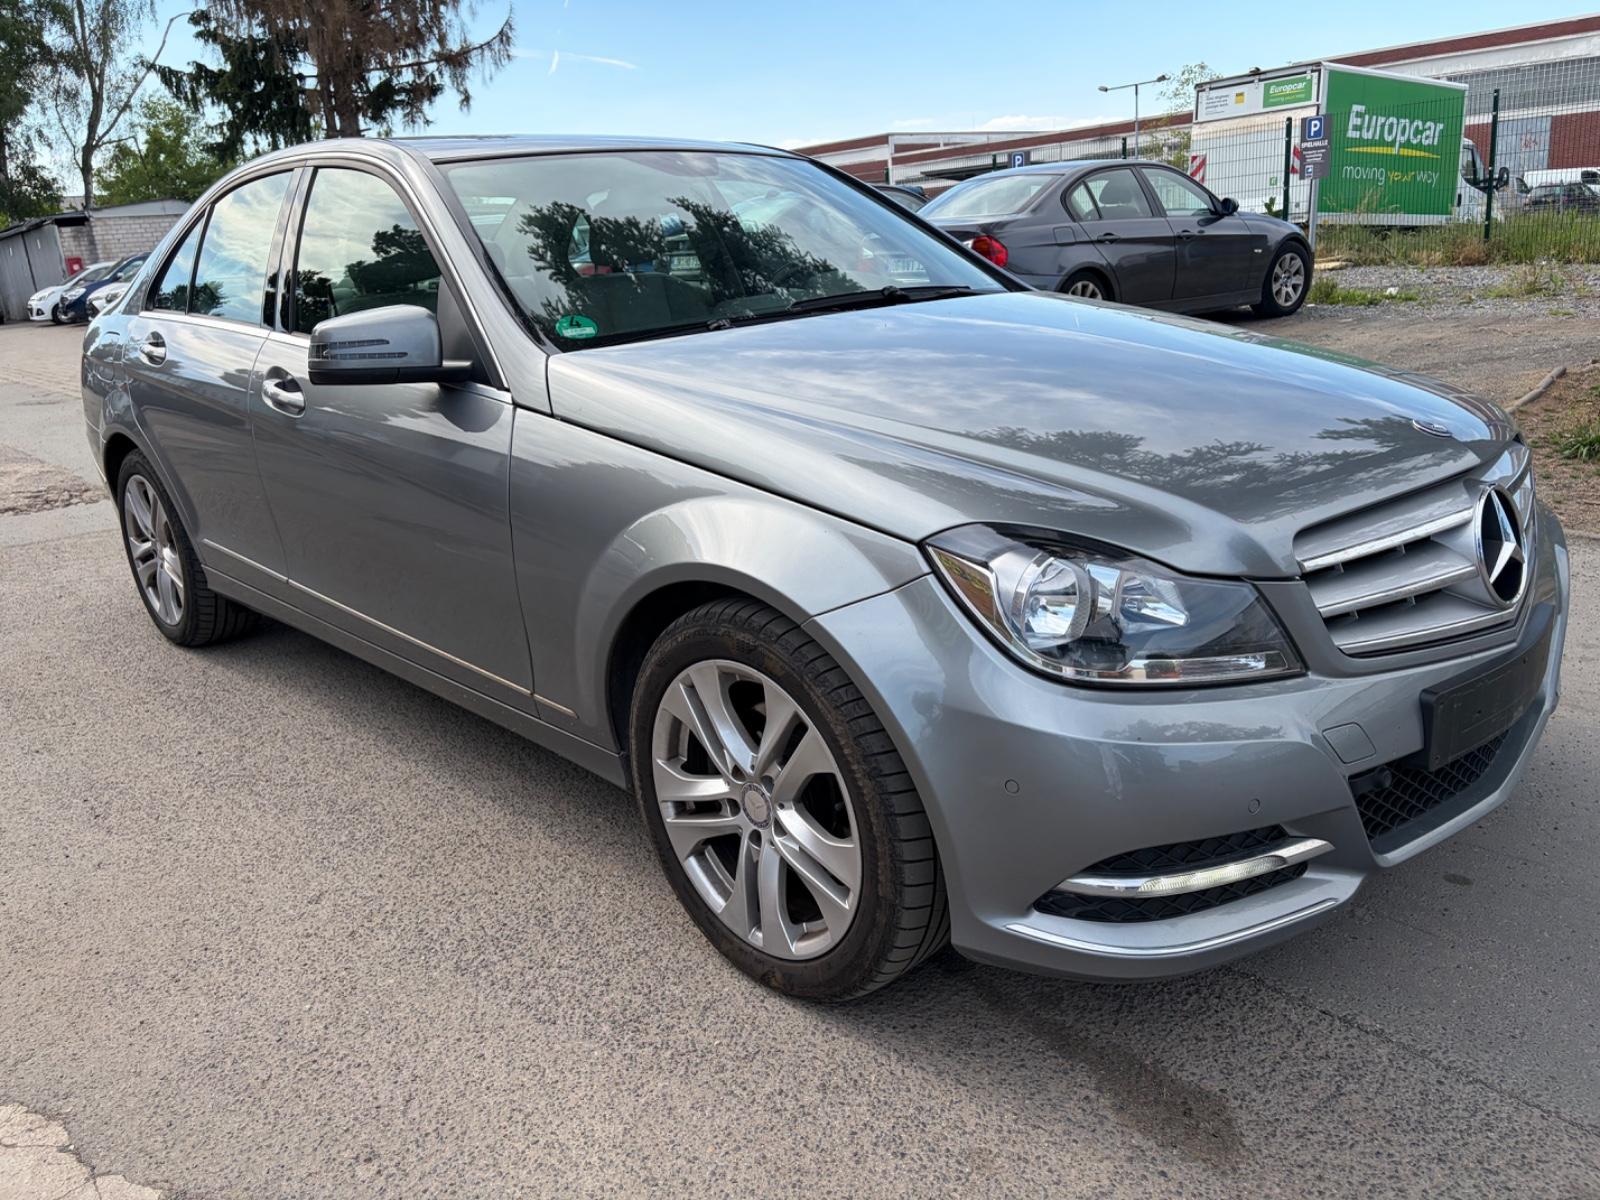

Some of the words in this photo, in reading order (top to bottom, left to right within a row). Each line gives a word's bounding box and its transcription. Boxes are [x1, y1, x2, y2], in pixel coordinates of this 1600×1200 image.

[1269, 82, 1306, 94] Europcar
[1311, 120, 1320, 136] P
[1346, 104, 1444, 154] Europcar
[1015, 155, 1022, 168] P
[1342, 165, 1386, 186] moving
[1387, 170, 1415, 186] your
[1415, 170, 1439, 188] way
[570, 316, 581, 327] 4
